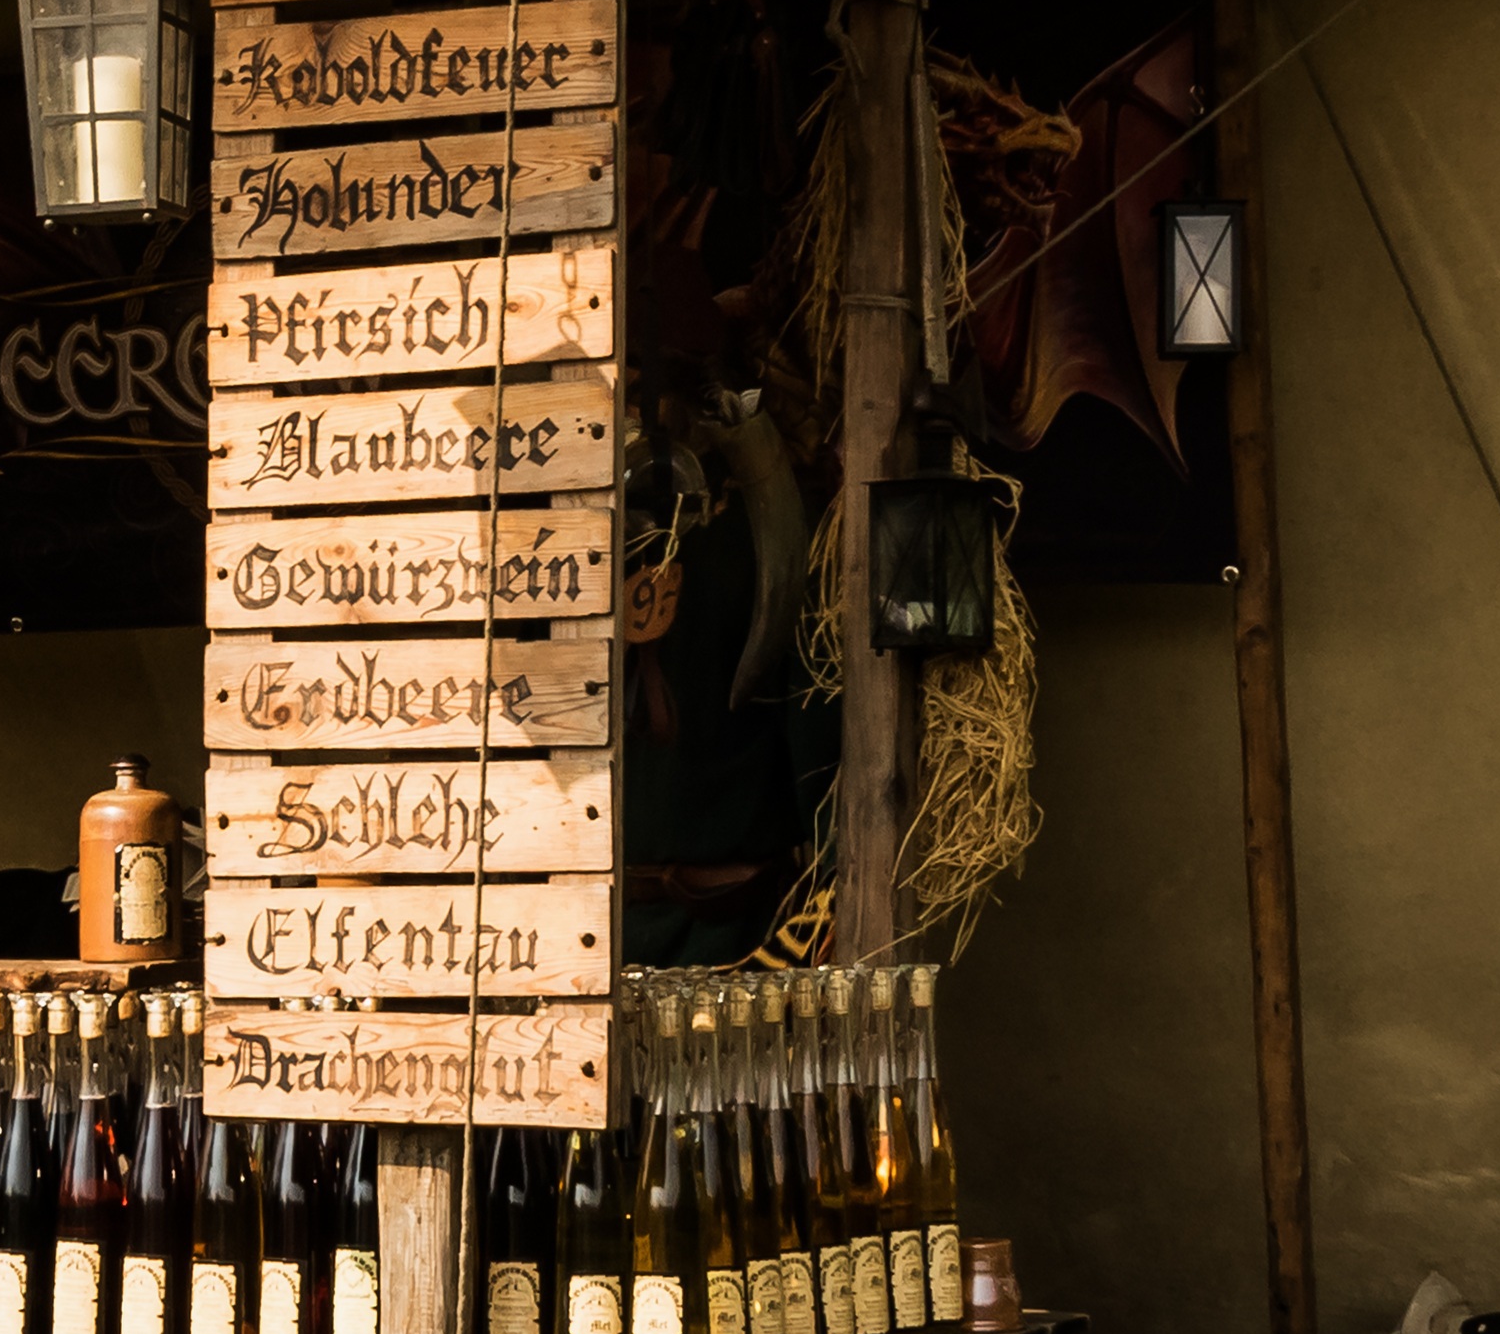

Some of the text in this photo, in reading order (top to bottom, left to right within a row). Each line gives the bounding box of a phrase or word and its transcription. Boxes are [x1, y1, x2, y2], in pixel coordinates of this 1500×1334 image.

[234, 27, 570, 115] Koboldfeuer
[239, 140, 520, 254] Holunder
[241, 263, 489, 363] Pfirsich
[242, 396, 559, 490] Blaubeere
[233, 527, 582, 617] Gewürzwein
[241, 650, 532, 730] Erdbeere
[258, 769, 504, 870] Schlehe
[248, 900, 538, 976] Elfentau
[227, 1023, 562, 1105] Drachenglut
